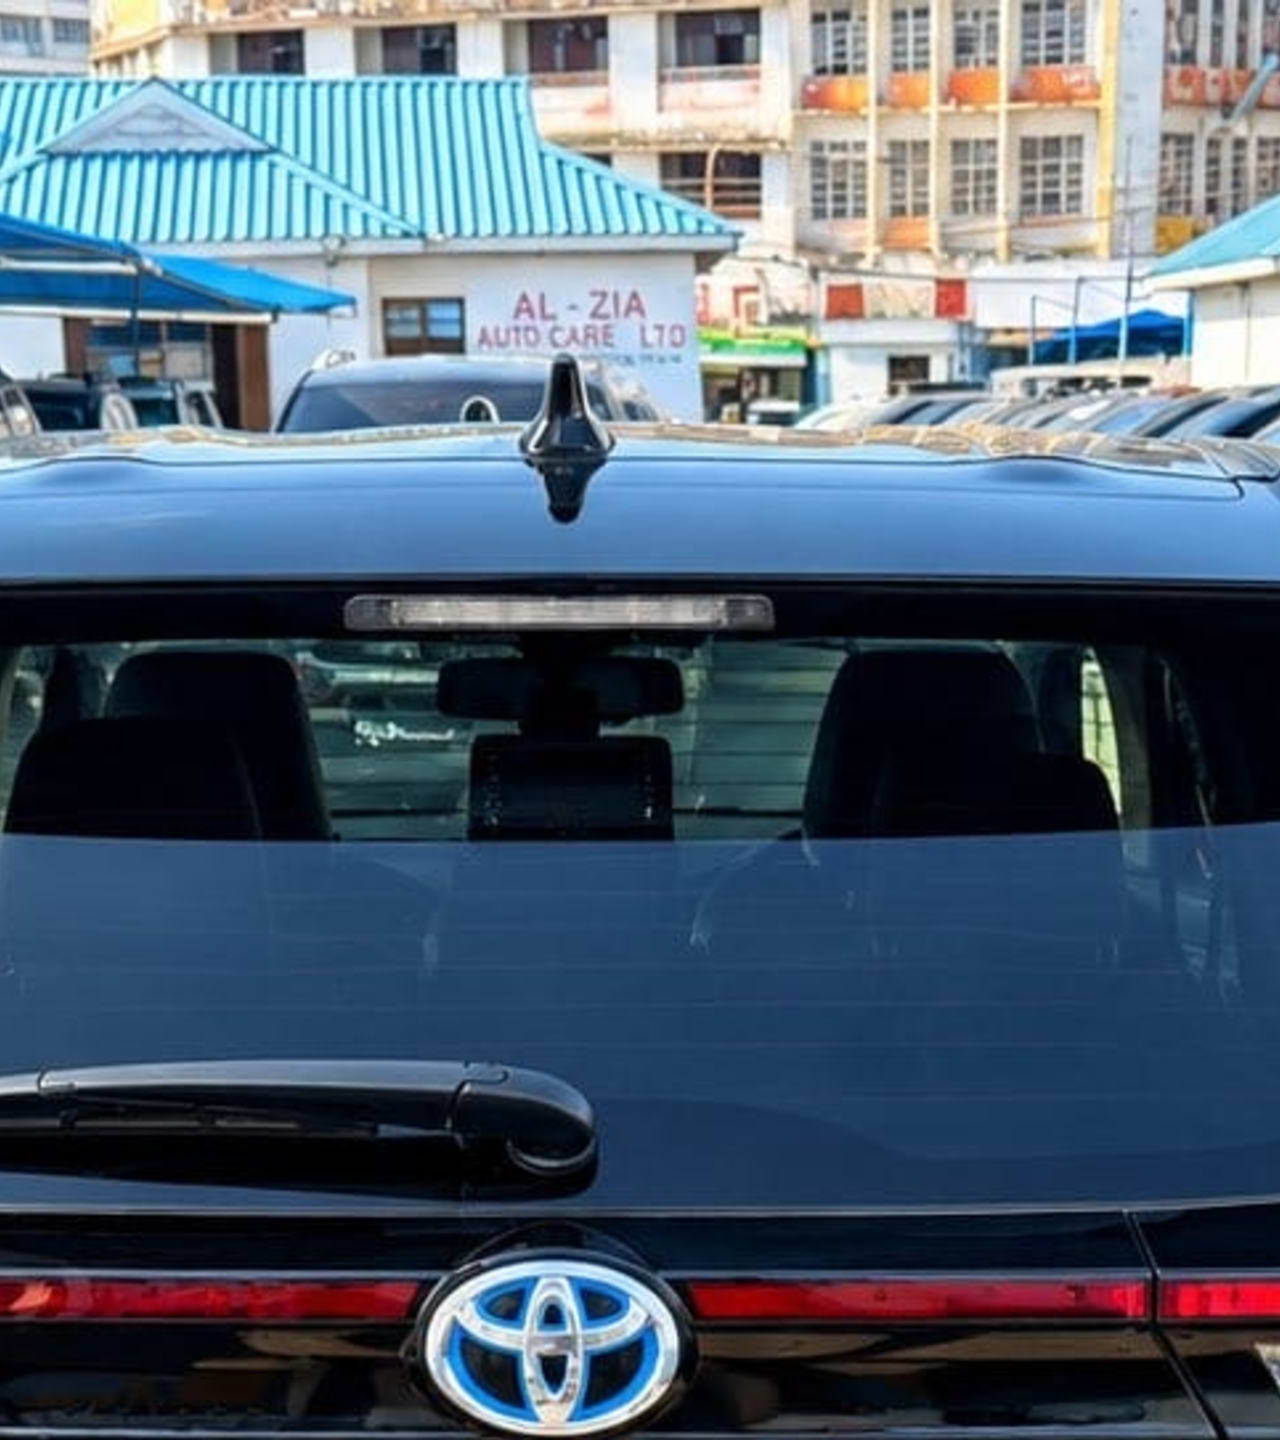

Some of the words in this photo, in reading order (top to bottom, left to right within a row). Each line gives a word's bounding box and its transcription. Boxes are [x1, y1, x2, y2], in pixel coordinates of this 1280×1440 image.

[513, 292, 557, 320] AL
[589, 291, 647, 320] ZIA
[478, 325, 541, 349] AUTO
[549, 324, 615, 349] CARE
